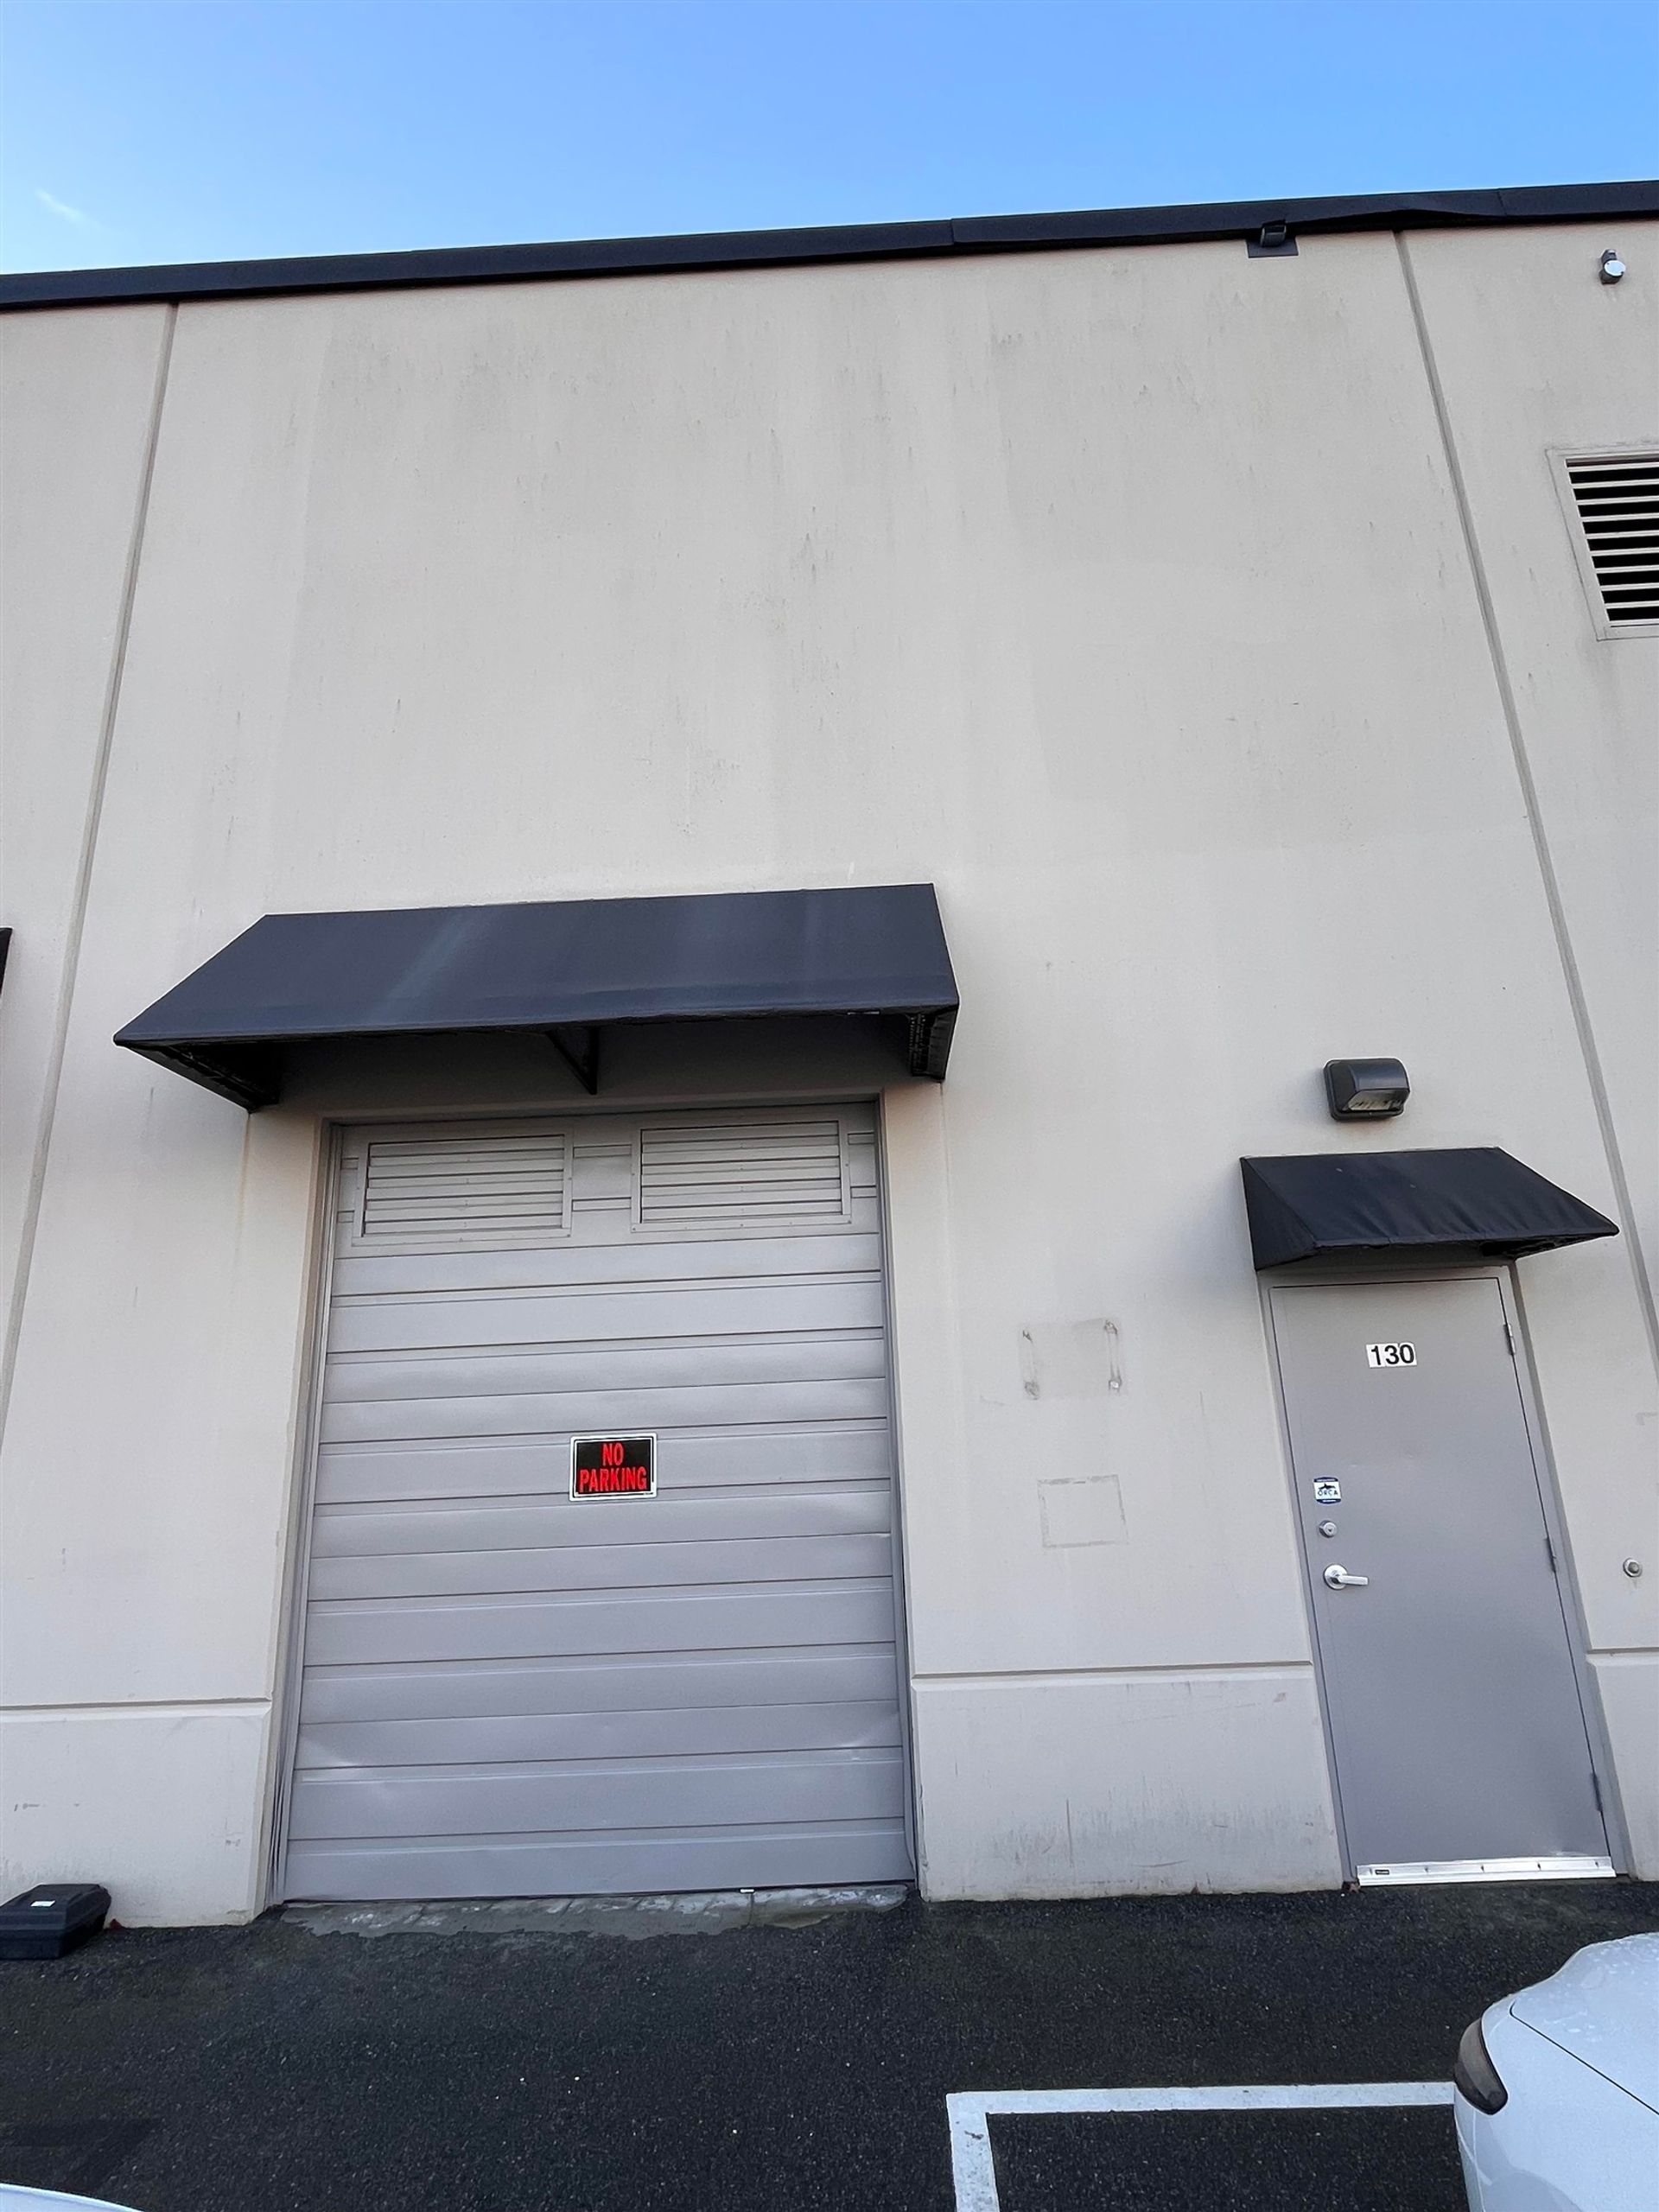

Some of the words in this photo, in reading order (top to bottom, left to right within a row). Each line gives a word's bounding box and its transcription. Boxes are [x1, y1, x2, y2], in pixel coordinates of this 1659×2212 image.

[1371, 1344, 1414, 1365] 130
[602, 1442, 624, 1466] NO
[579, 1466, 647, 1493] PARKING
